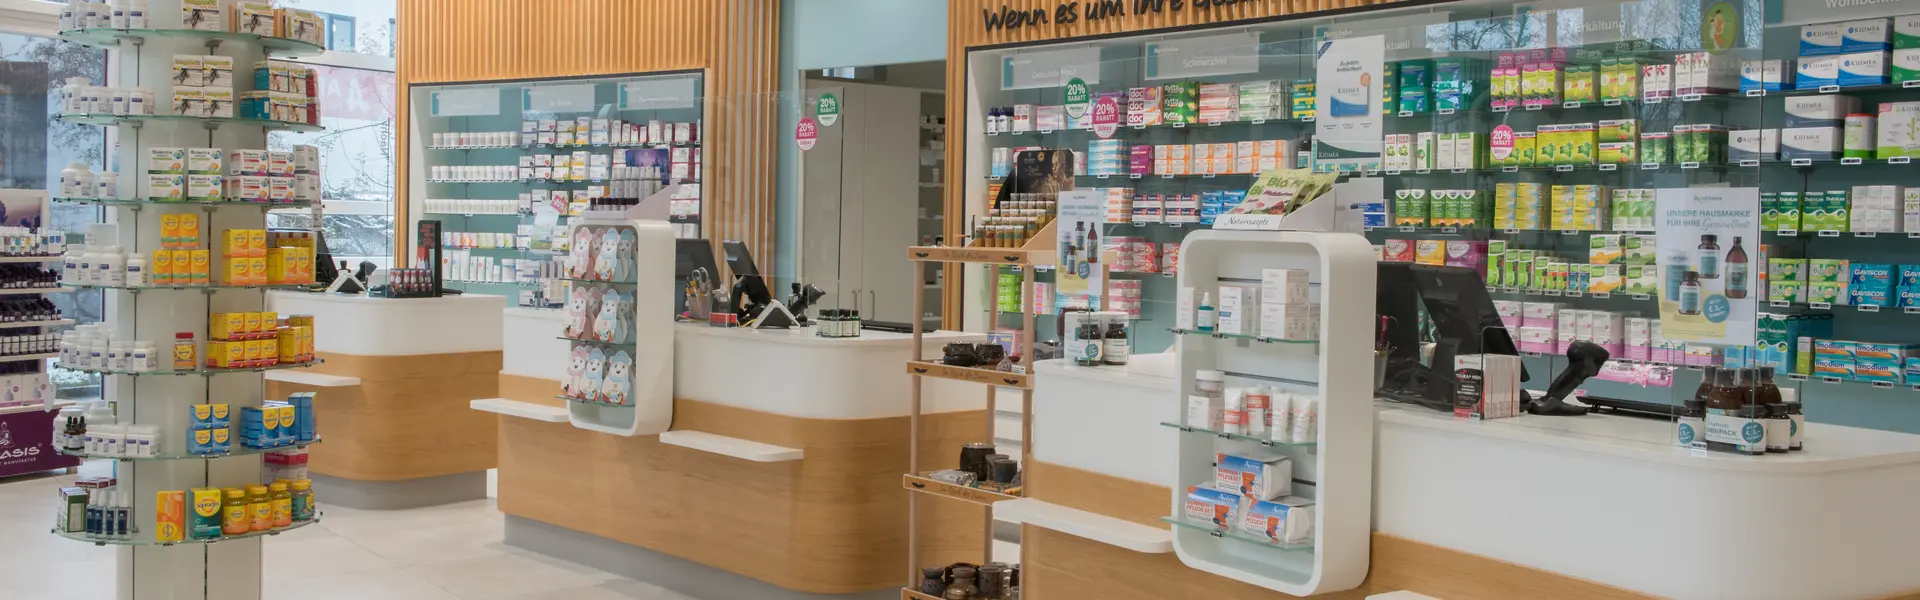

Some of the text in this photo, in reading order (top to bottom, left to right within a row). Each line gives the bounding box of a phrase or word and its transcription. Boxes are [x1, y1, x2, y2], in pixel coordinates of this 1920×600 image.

[983, 8, 1048, 32] Wenn
[1054, 1, 1078, 25] es
[1085, 0, 1125, 20] um
[1575, 20, 1626, 33] Erkältung
[1855, 26, 1880, 34] KIJIMEA
[1384, 40, 1411, 51] ktuell
[1182, 56, 1227, 69] Schmerzfrei
[1067, 84, 1086, 95] 20%
[1129, 88, 1143, 98] doc
[1067, 94, 1086, 102] RABATT
[1164, 98, 1179, 107] Kytta
[820, 98, 835, 108] 20%
[1129, 101, 1143, 112] doc
[1796, 102, 1822, 110] KIJIMEA
[1096, 103, 1115, 114] 20%
[1096, 113, 1115, 122] RABATT
[1128, 114, 1143, 124] doc
[1163, 112, 1179, 121] Kytta
[799, 123, 814, 132] 20%
[1493, 130, 1512, 140] 20%
[1266, 176, 1288, 188] Bio
[1666, 218, 1750, 231] FÜR IHRE Gesundheit
[1816, 342, 1846, 350] Imodium
[1816, 360, 1845, 368] Imodium
[1218, 468, 1241, 477] SONNEN-
[1218, 474, 1242, 483] PFLEGESET
[196, 501, 220, 509] Supradyn
[1187, 500, 1212, 508] SONNEN-
[1186, 505, 1214, 514] PFLEGESET
